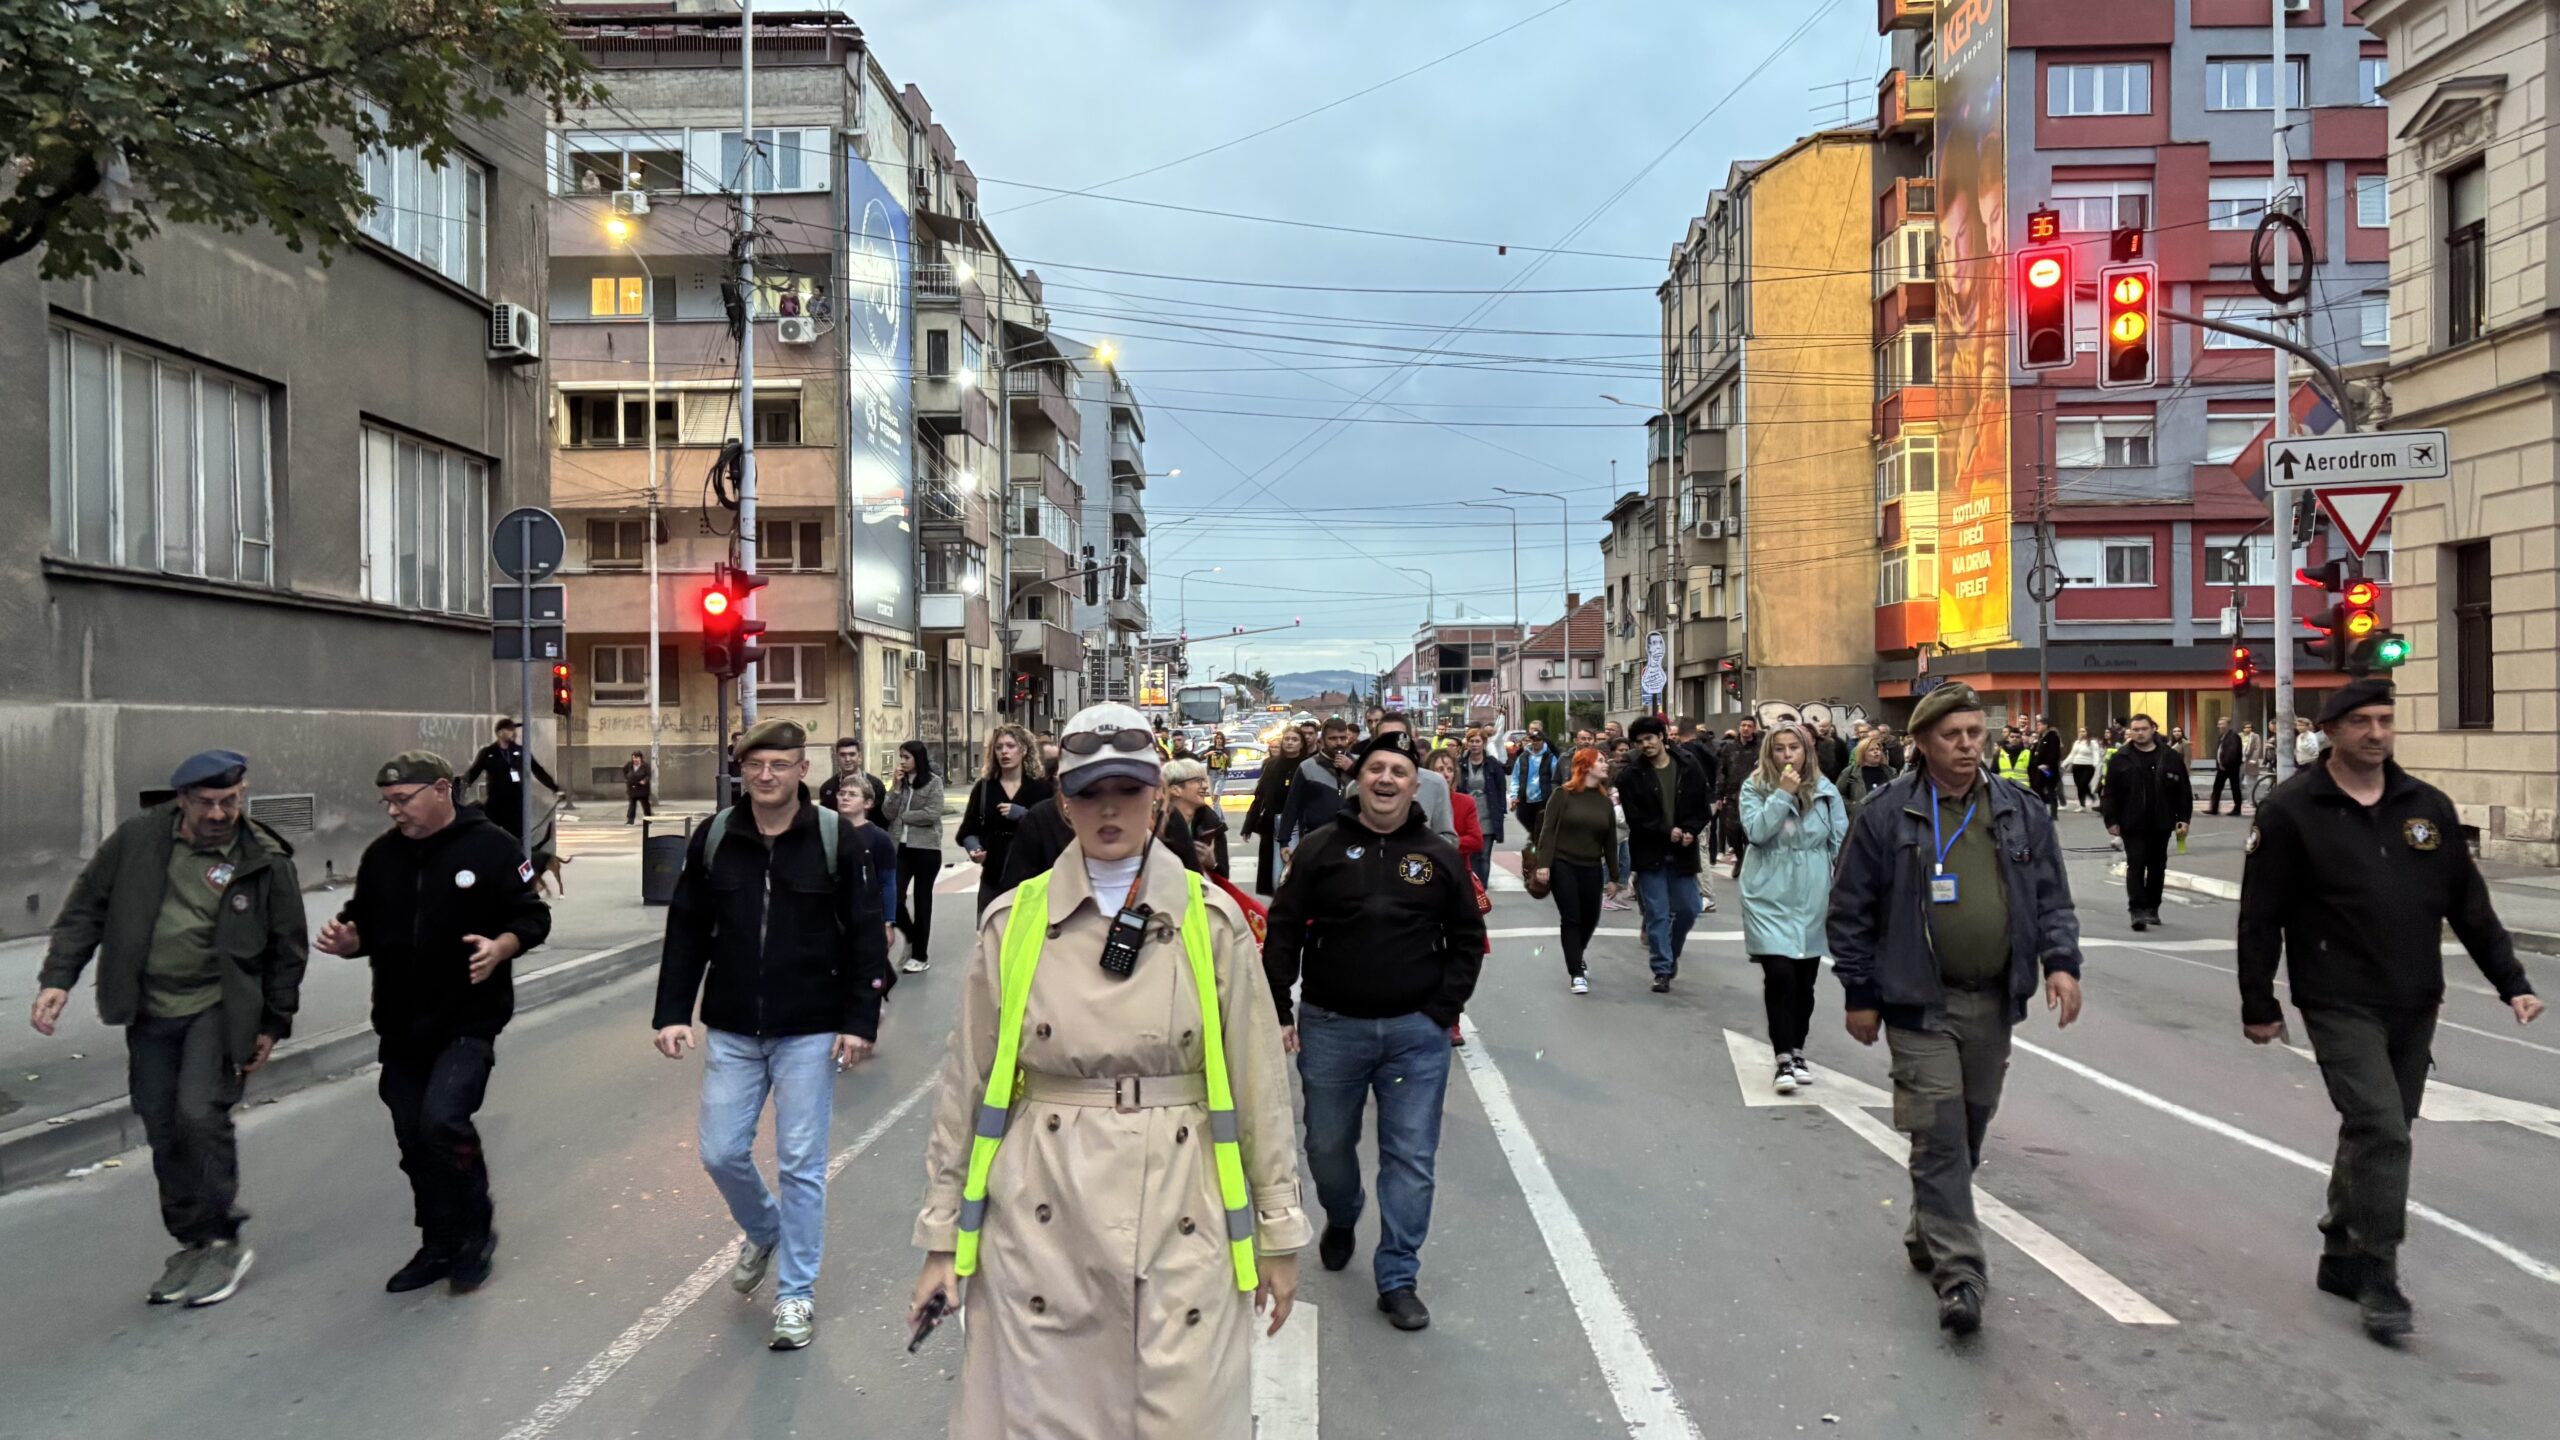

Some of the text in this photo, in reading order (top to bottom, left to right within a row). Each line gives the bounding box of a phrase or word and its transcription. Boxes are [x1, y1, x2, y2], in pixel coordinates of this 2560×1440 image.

[1943, 0, 1993, 64] KEPO
[1943, 27, 1994, 84] www.kepo.rs
[2304, 450, 2397, 472] Aerodrom
[1952, 496, 1990, 524] KOTLOVI
[1963, 521, 1984, 546] PEĆI
[1952, 549, 1992, 575] NA DRVA
[1960, 576, 1988, 599] PELET
